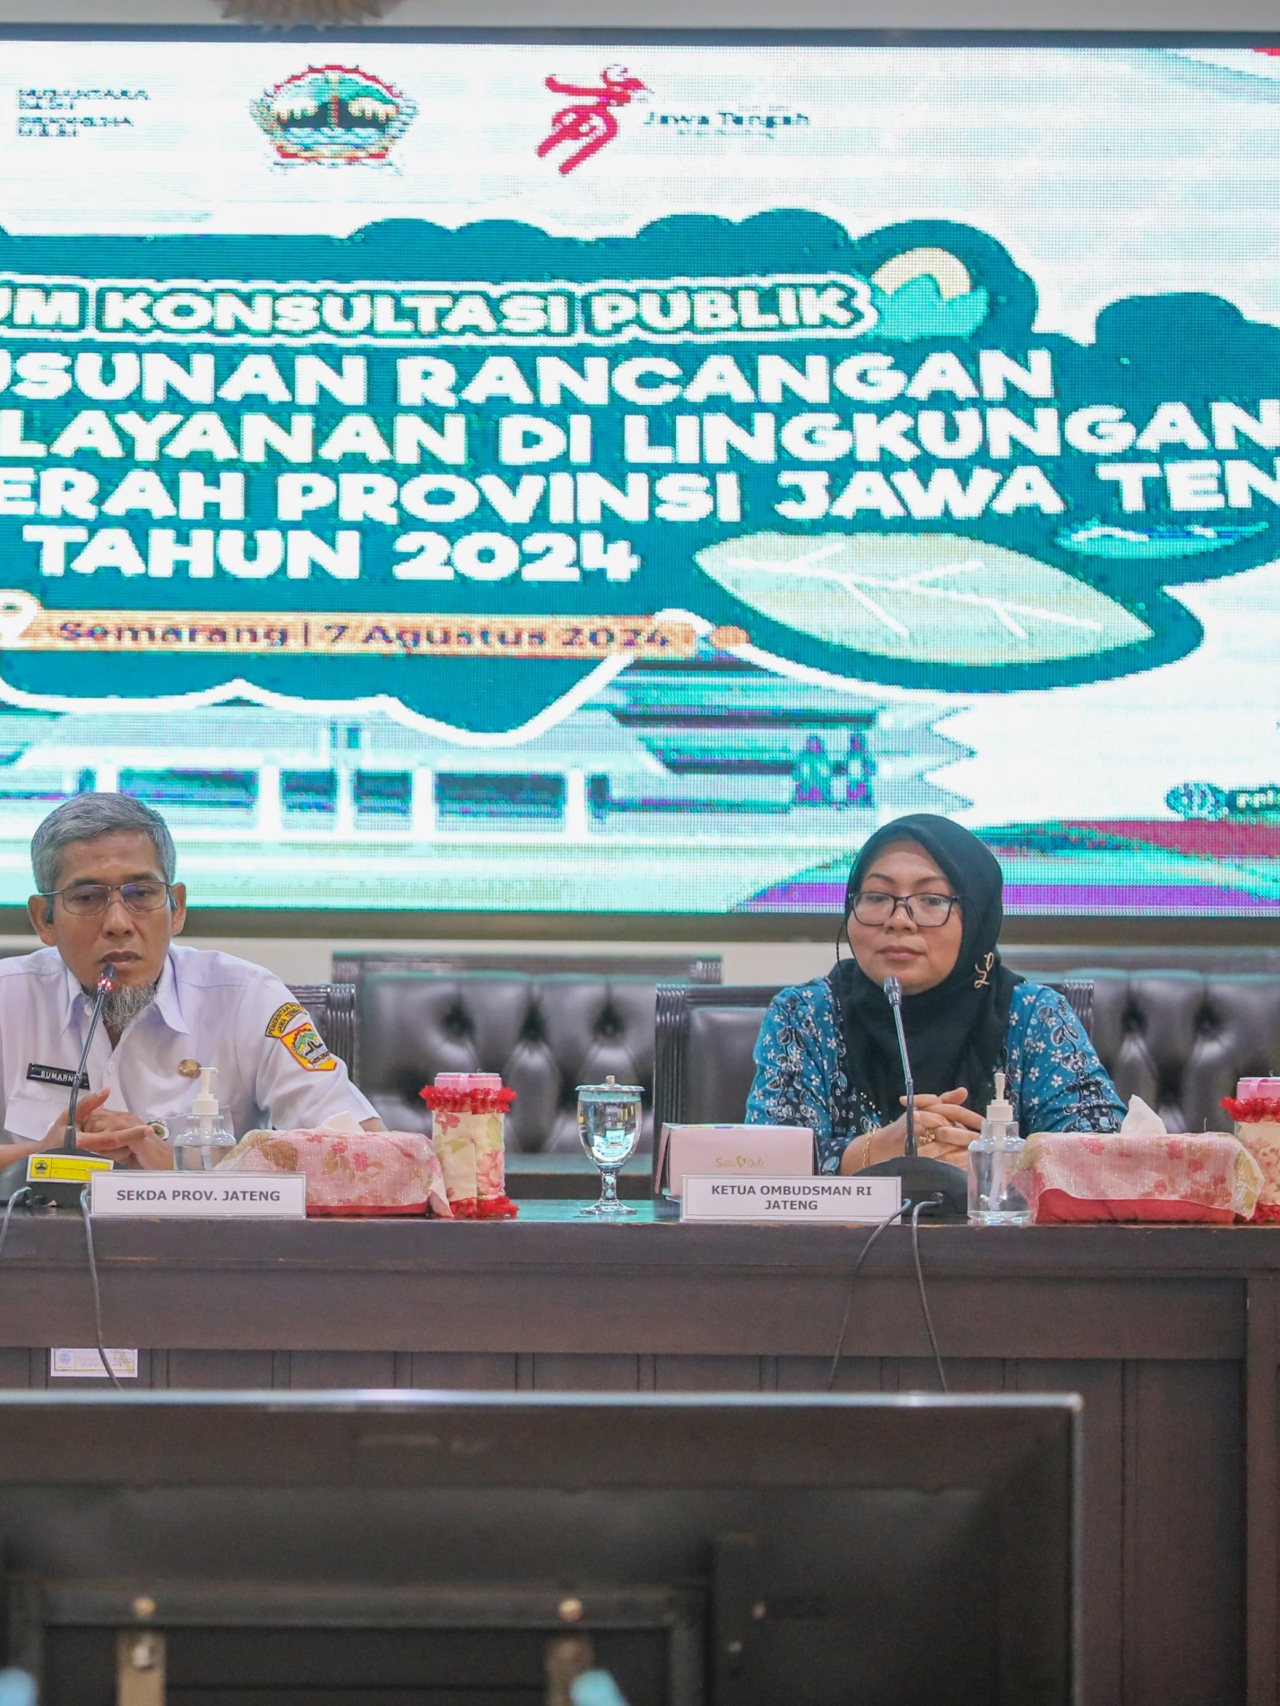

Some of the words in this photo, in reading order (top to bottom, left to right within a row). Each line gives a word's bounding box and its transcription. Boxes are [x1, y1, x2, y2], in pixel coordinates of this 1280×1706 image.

[104, 288, 570, 334] KONSULTASI
[589, 286, 857, 331] PUBLIK
[398, 350, 1054, 407] RANCANGAN
[500, 414, 592, 465] DI
[625, 399, 1280, 464] LINGKUNGAN
[277, 472, 741, 524] PROVINSI
[775, 466, 1064, 519] JAWA
[23, 525, 360, 579] TAHUN
[393, 531, 640, 581] 2024
[60, 622, 288, 648] Semarang
[324, 625, 349, 643] 7
[362, 625, 546, 653] Agustus
[560, 627, 671, 648] 2024
[40, 1070, 80, 1082] SUMARN
[116, 1189, 167, 1201] SEKDA
[172, 1190, 217, 1201] PROV.
[222, 1190, 280, 1202] JATENG
[711, 1185, 756, 1195] KETUA
[760, 1185, 851, 1196] OMBUDSMAN
[856, 1186, 872, 1196] RI
[765, 1200, 818, 1210] JATENG
